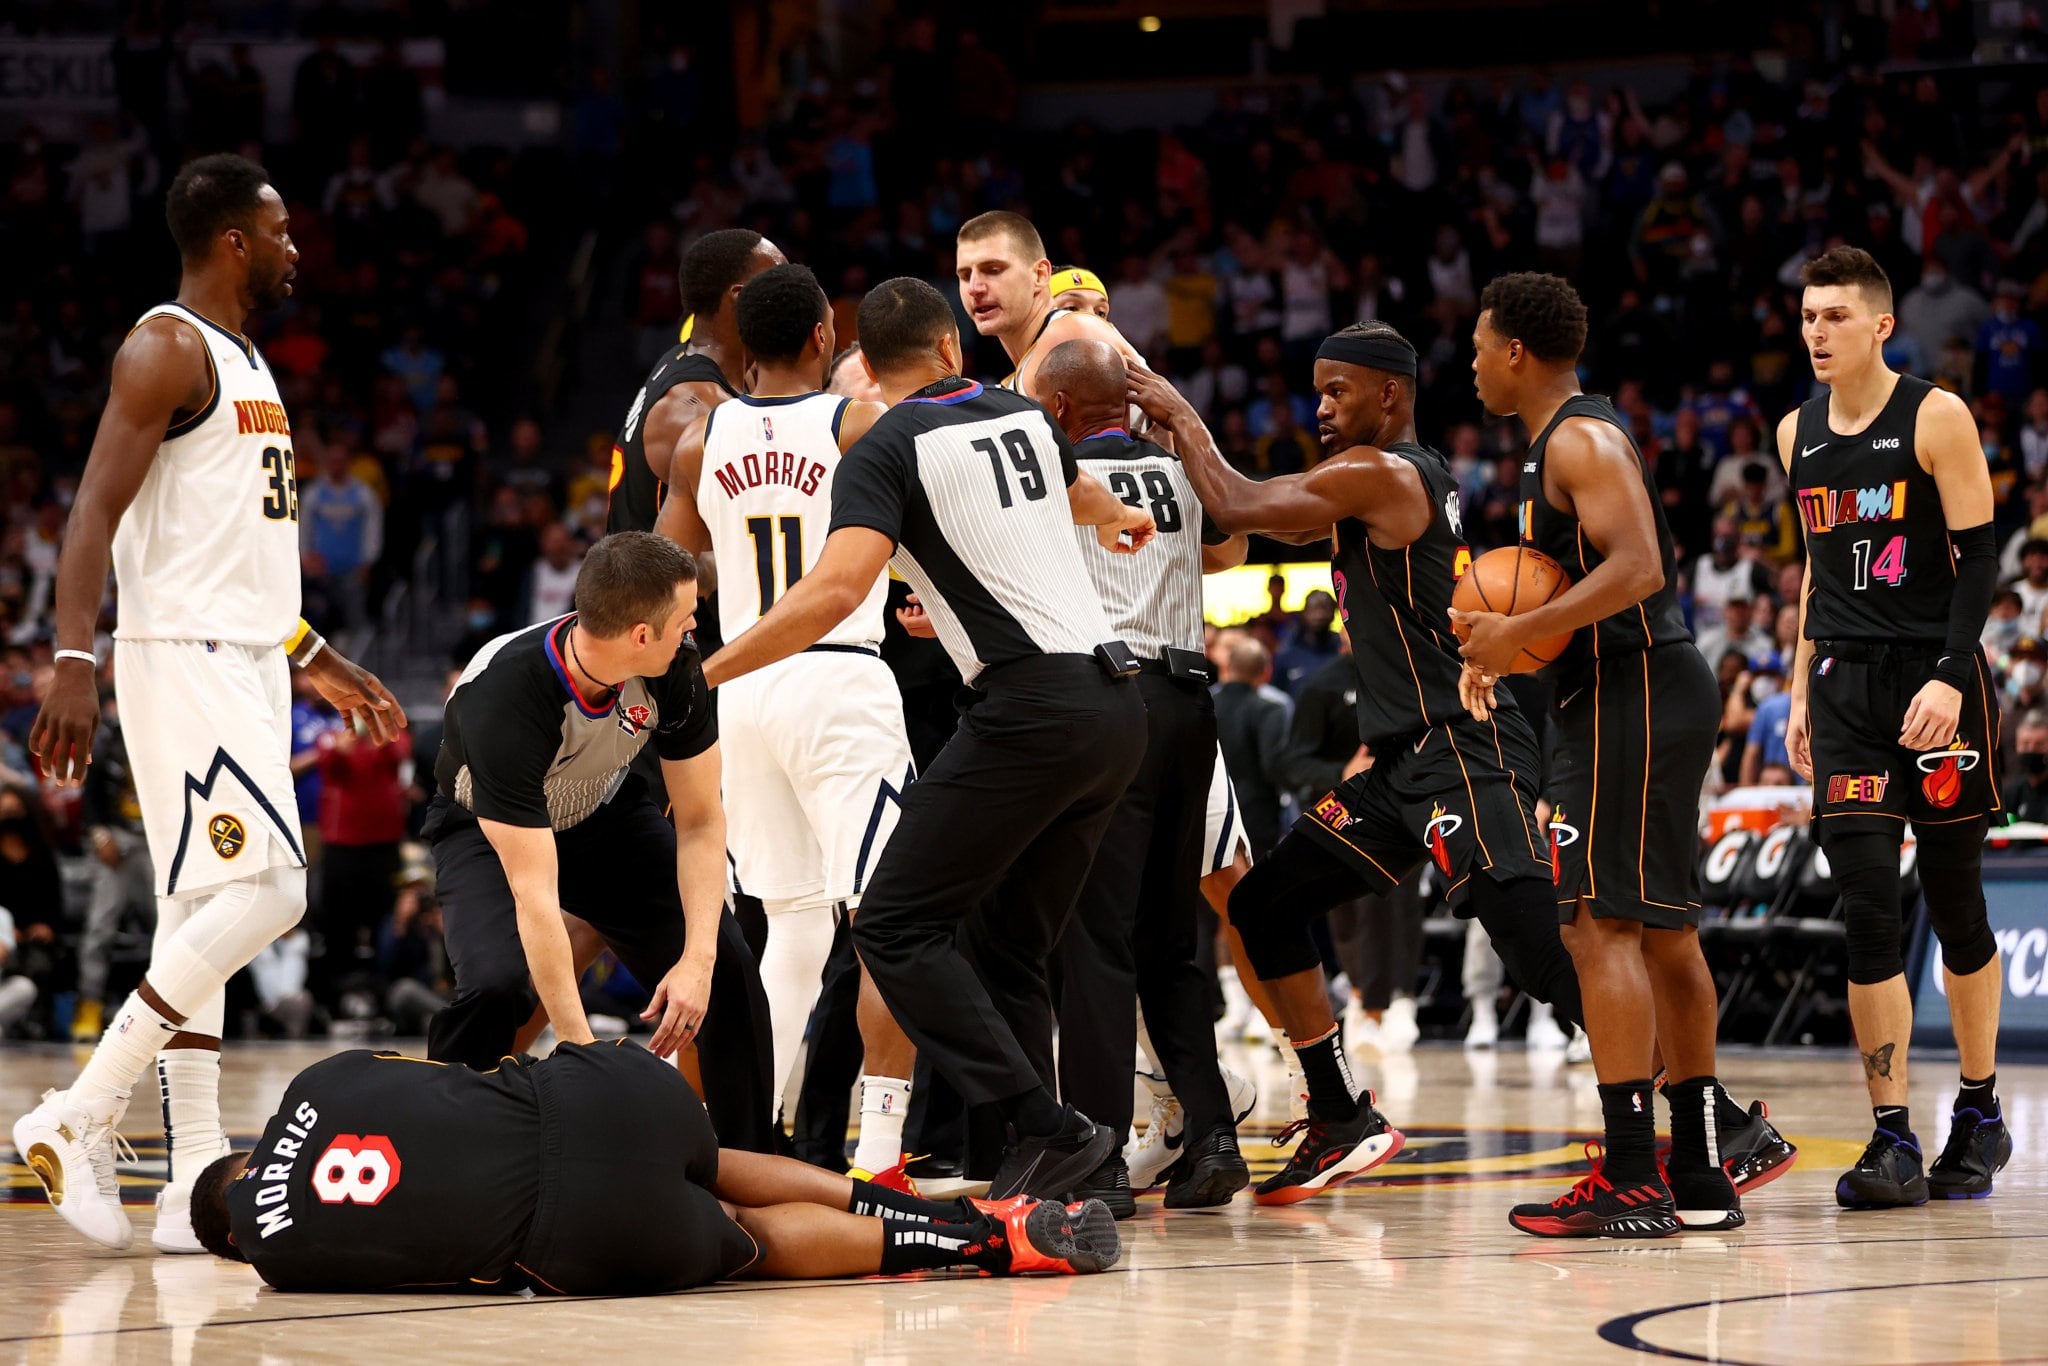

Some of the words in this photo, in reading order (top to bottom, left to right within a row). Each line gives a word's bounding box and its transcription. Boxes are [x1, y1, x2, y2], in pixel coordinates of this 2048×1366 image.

[924, 381, 943, 395] NIKE
[943, 376, 957, 387] PRO
[970, 428, 1048, 509] 79
[1872, 438, 1900, 450] UKG
[714, 451, 827, 500] MORRIS
[745, 513, 804, 619] 11
[1853, 535, 1908, 591] 14
[255, 1101, 319, 1239] MORRIS
[311, 1133, 402, 1206] 8
[962, 1243, 983, 1256] NIKE
